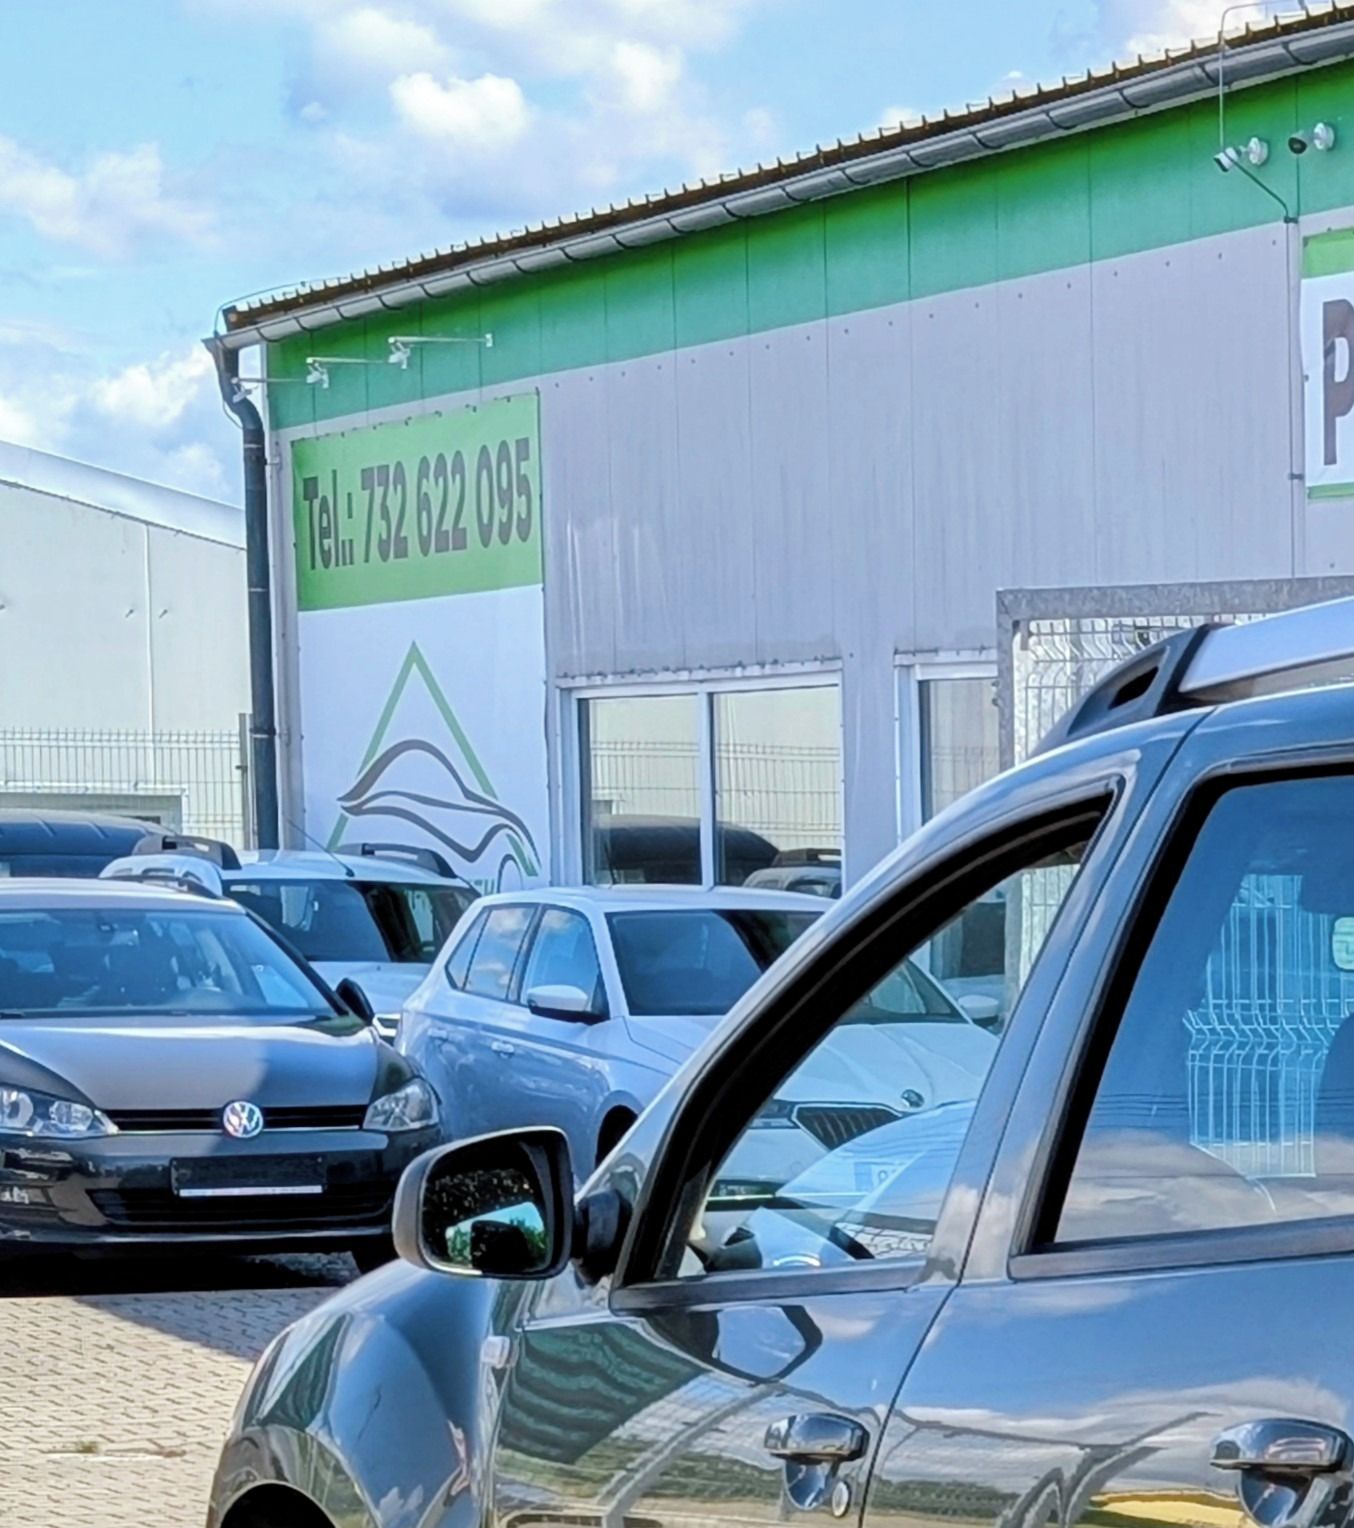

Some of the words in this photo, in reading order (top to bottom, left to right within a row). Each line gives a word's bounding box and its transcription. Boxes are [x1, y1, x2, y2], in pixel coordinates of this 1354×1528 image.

[302, 468, 355, 571] Tel.:
[361, 460, 409, 565] 732
[415, 449, 468, 557] 622
[475, 437, 533, 549] 095
